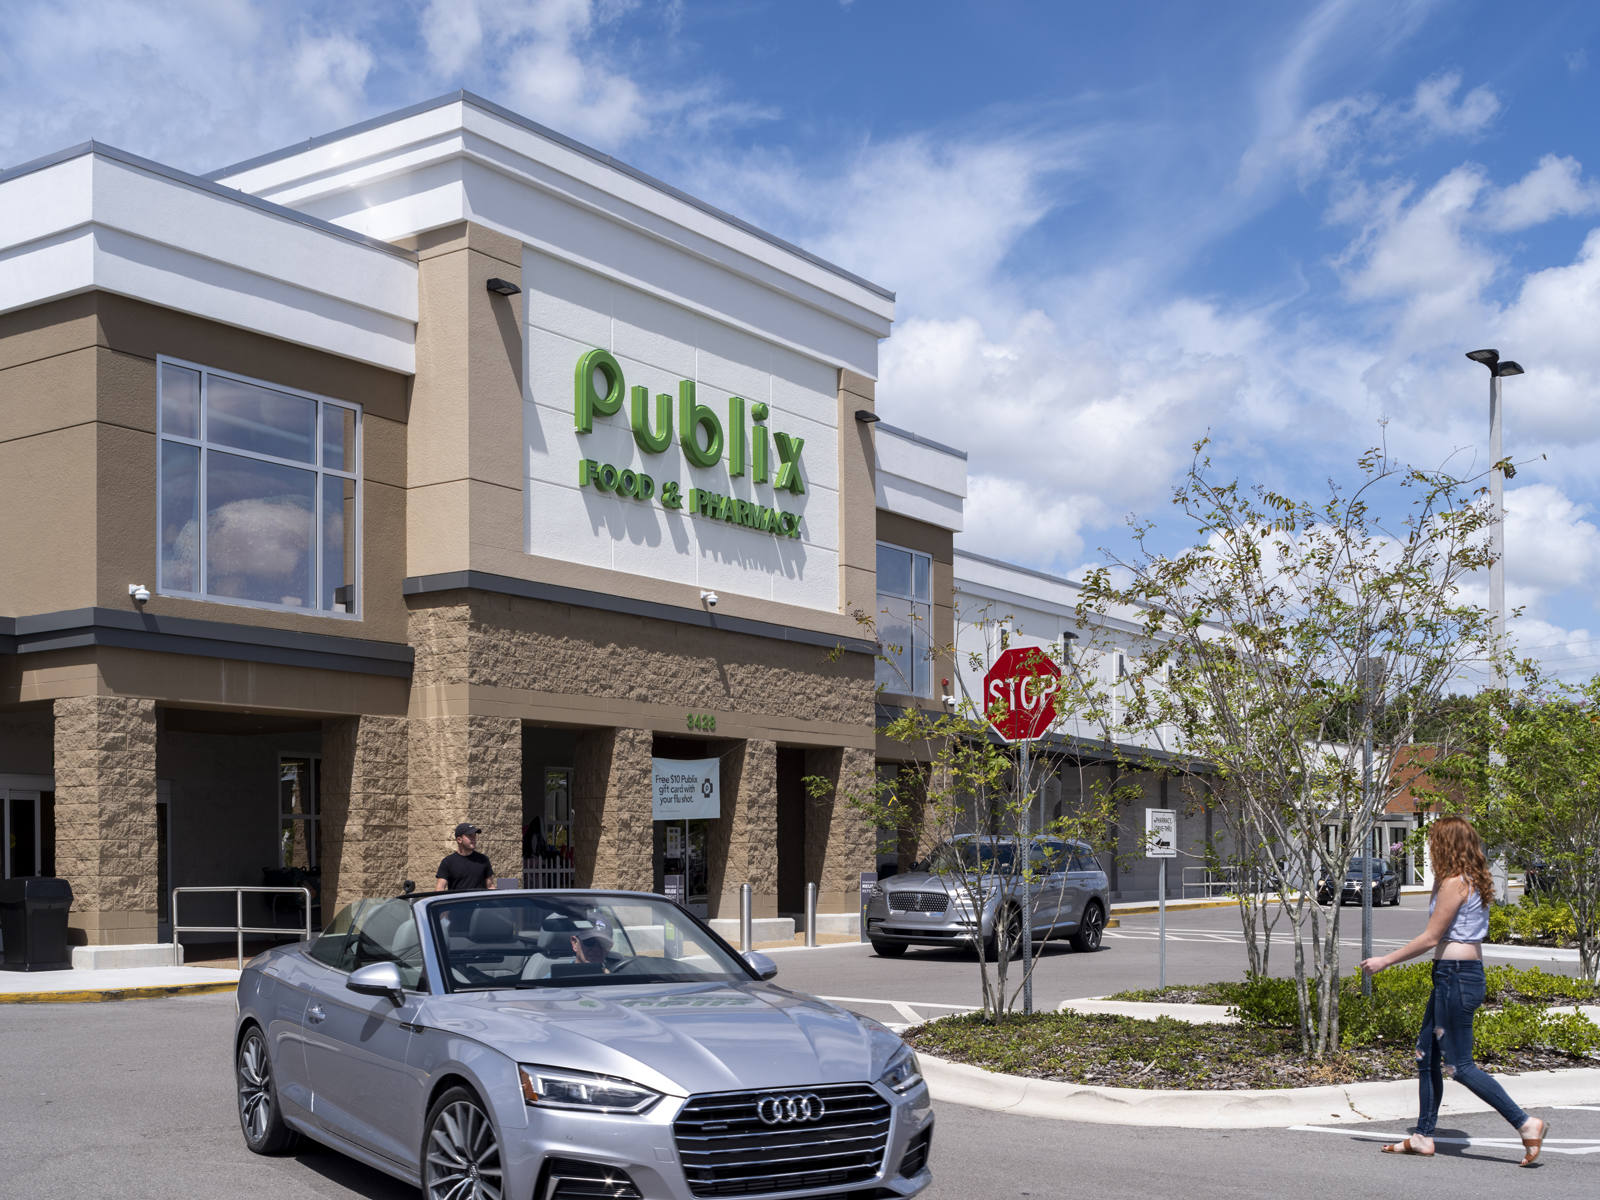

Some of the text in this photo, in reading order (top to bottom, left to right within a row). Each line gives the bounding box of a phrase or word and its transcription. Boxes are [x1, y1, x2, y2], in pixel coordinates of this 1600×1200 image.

[574, 348, 805, 496] Publix
[579, 458, 803, 539] FOOD & PHARMACY
[988, 674, 1057, 712] STOP
[686, 712, 717, 730] 3428
[655, 774, 698, 784] Free $10 Publix
[658, 784, 696, 796] gift card with
[660, 796, 673, 806] your
